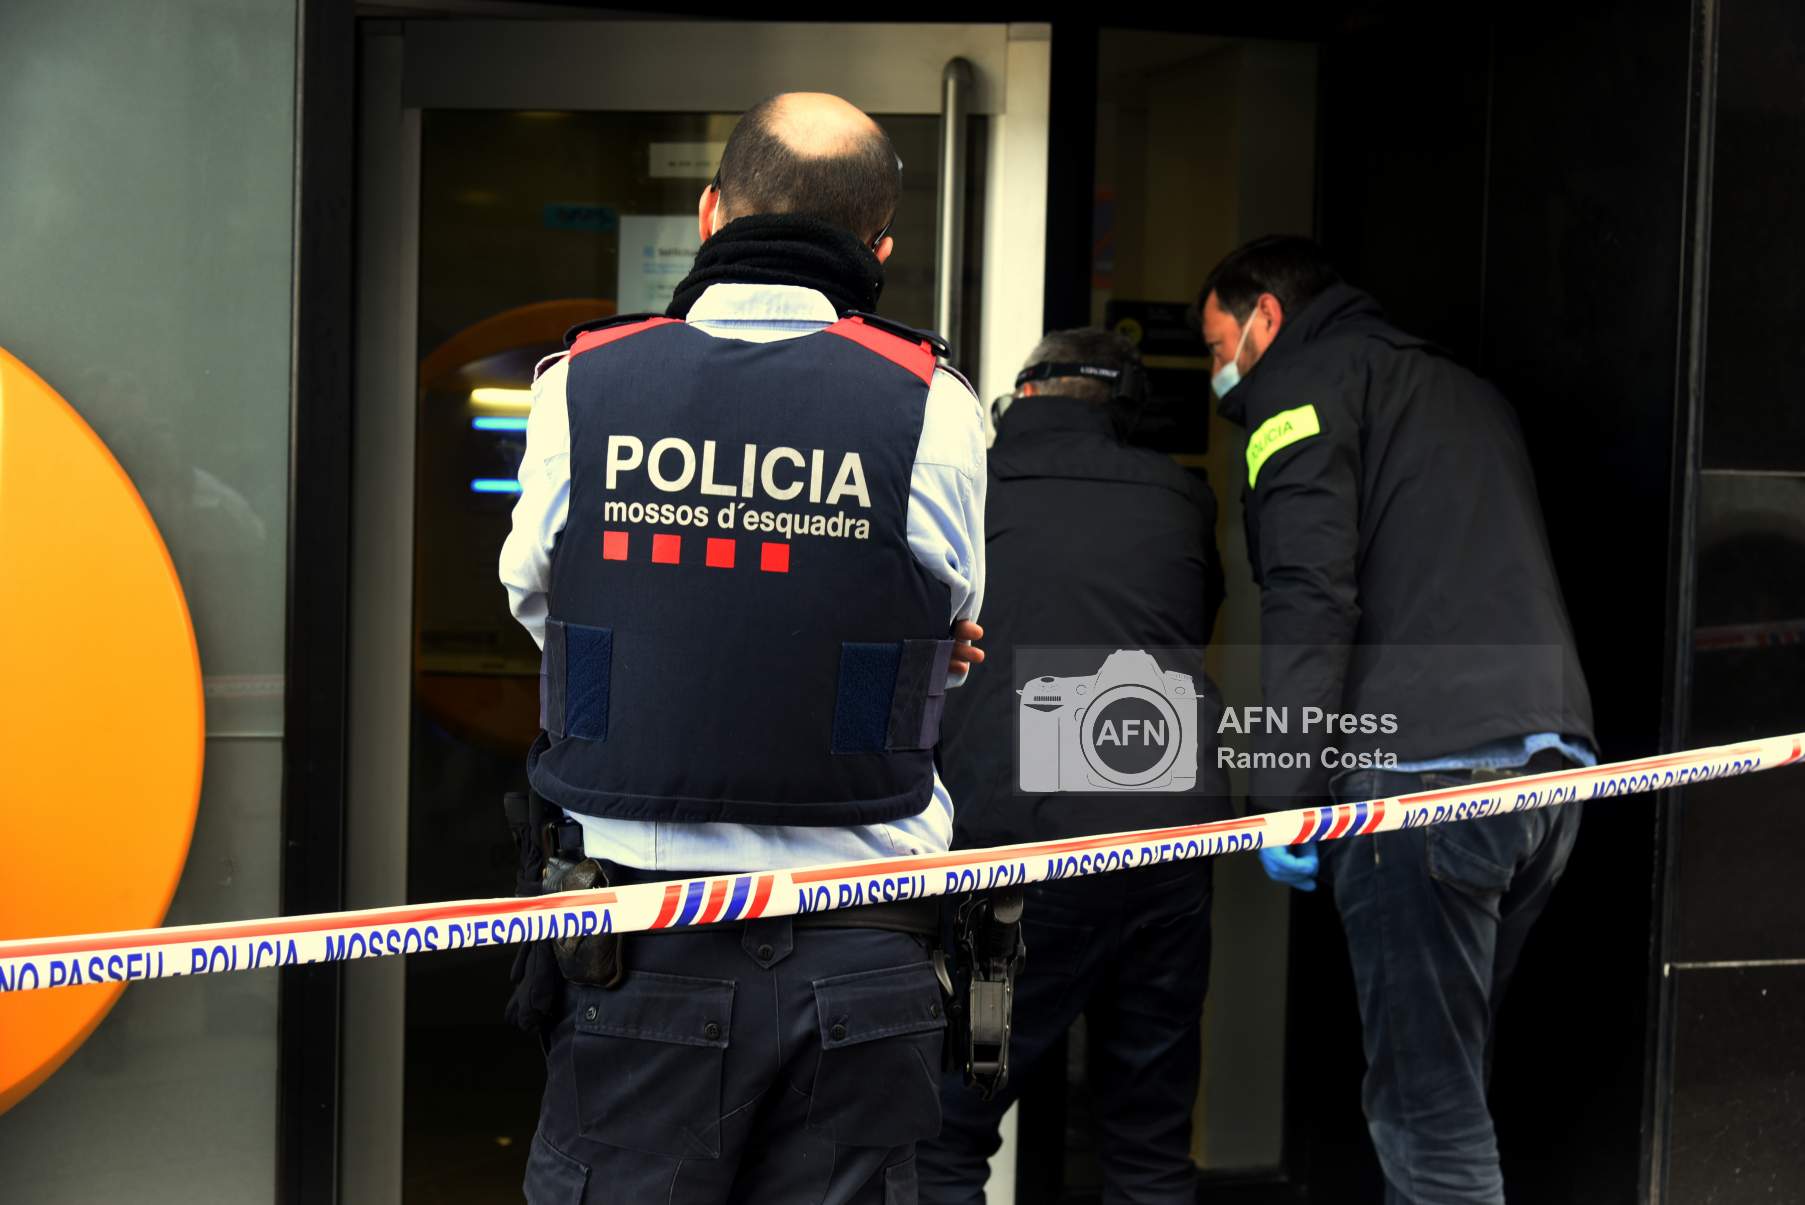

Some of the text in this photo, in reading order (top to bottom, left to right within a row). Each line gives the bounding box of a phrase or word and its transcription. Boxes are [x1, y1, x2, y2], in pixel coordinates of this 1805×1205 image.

[605, 435, 872, 507] POLICIA
[604, 501, 709, 527] mossos
[797, 885, 831, 914] NO
[838, 875, 926, 908] PASSEU
[945, 863, 1026, 894] POLICIA
[1045, 849, 1134, 880] MOSSOS
[0, 962, 39, 992] NO
[50, 951, 164, 988] PASSEU
[190, 939, 299, 975] POLICIA
[324, 925, 439, 962] MOSSOS
